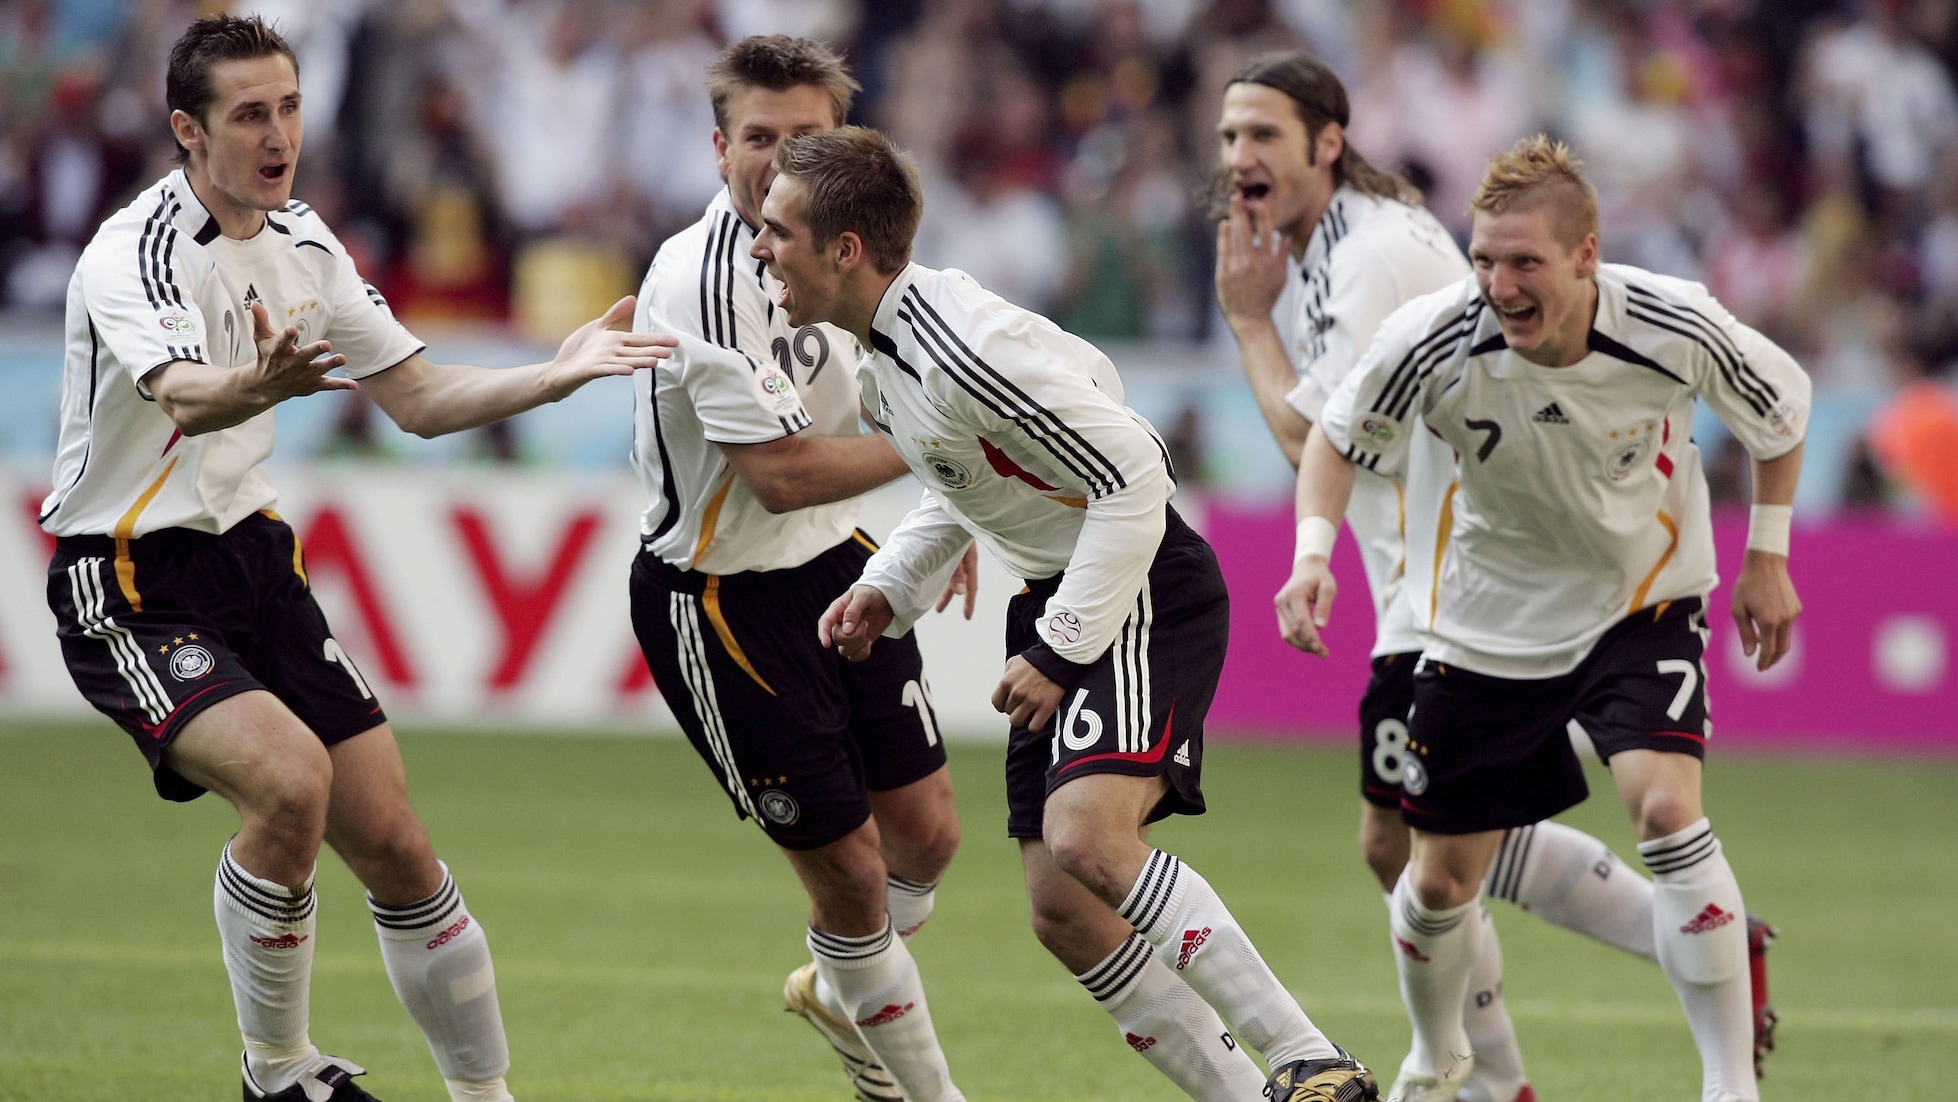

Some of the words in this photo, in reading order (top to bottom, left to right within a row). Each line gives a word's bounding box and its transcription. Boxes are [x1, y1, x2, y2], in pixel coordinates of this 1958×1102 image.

[770, 324, 830, 388] 19
[1464, 417, 1502, 464] 7
[1656, 659, 1698, 722] 7
[1373, 718, 1410, 784] 8
[1176, 926, 1212, 970] adidas
[1680, 911, 1735, 934] adidas
